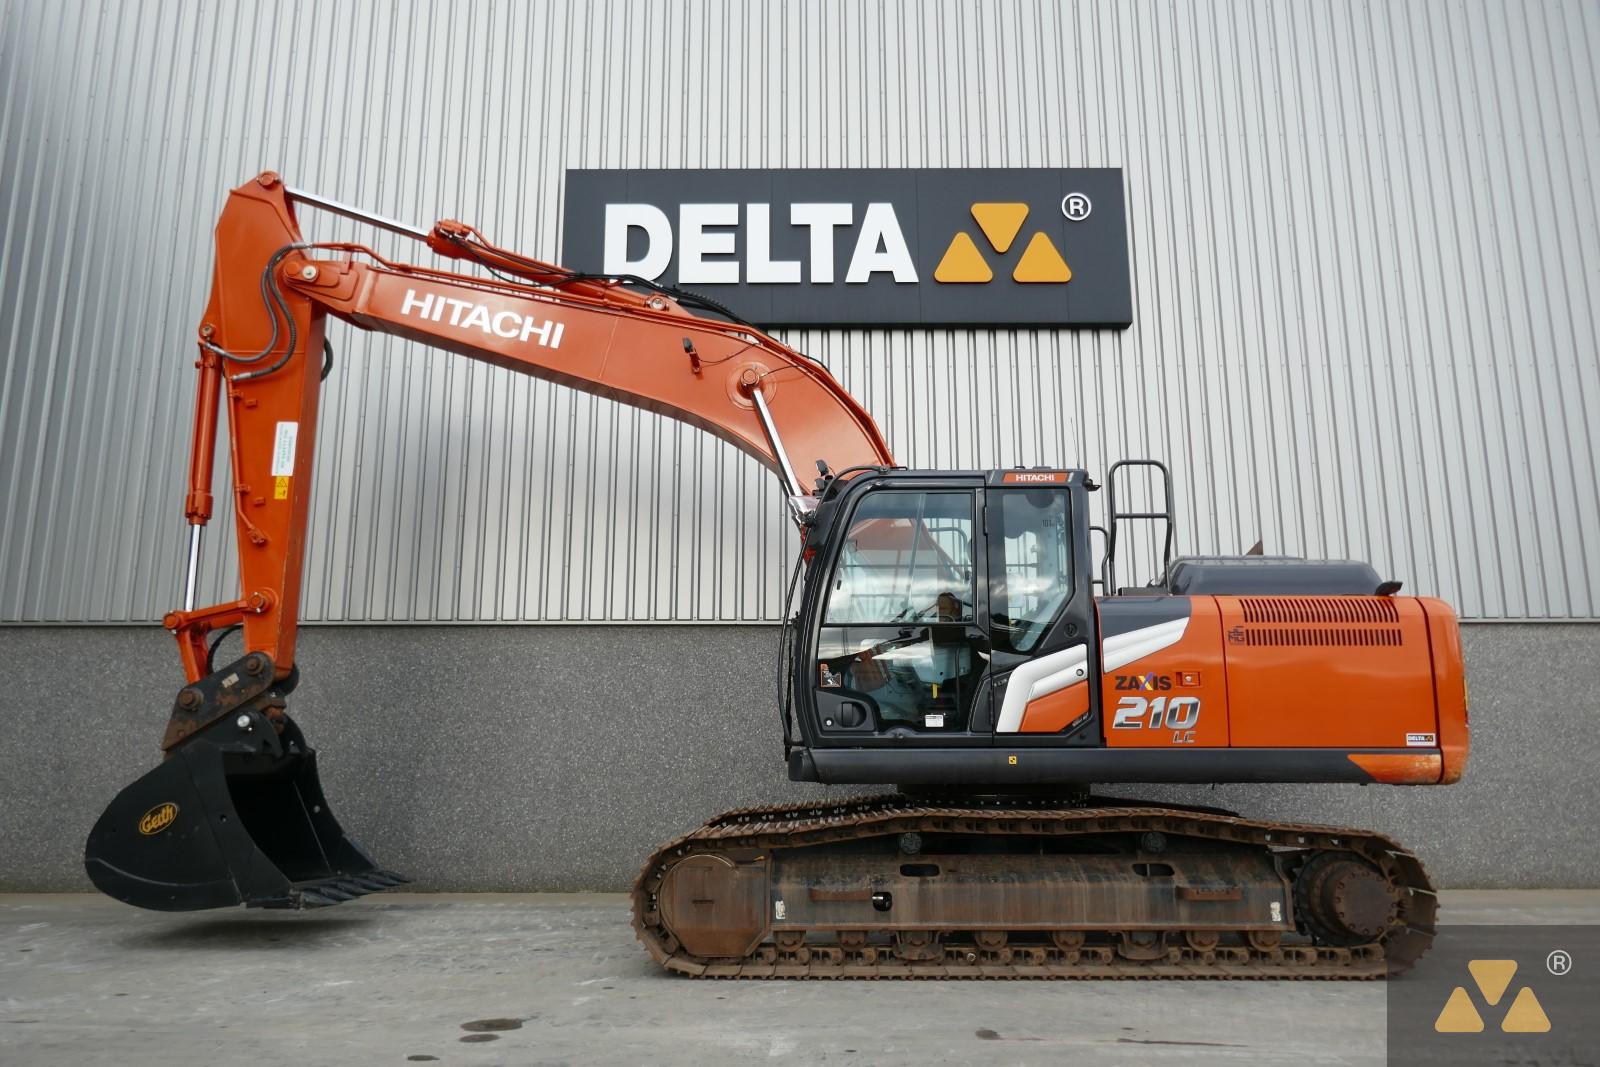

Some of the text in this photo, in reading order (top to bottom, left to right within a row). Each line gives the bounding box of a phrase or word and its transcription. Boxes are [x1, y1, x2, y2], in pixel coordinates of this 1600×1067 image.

[604, 203, 919, 283] DELTA
[401, 289, 565, 349] HITACHI
[1115, 672, 1172, 691] ZAXIS
[1112, 696, 1201, 729] 210
[1172, 730, 1196, 744] LC
